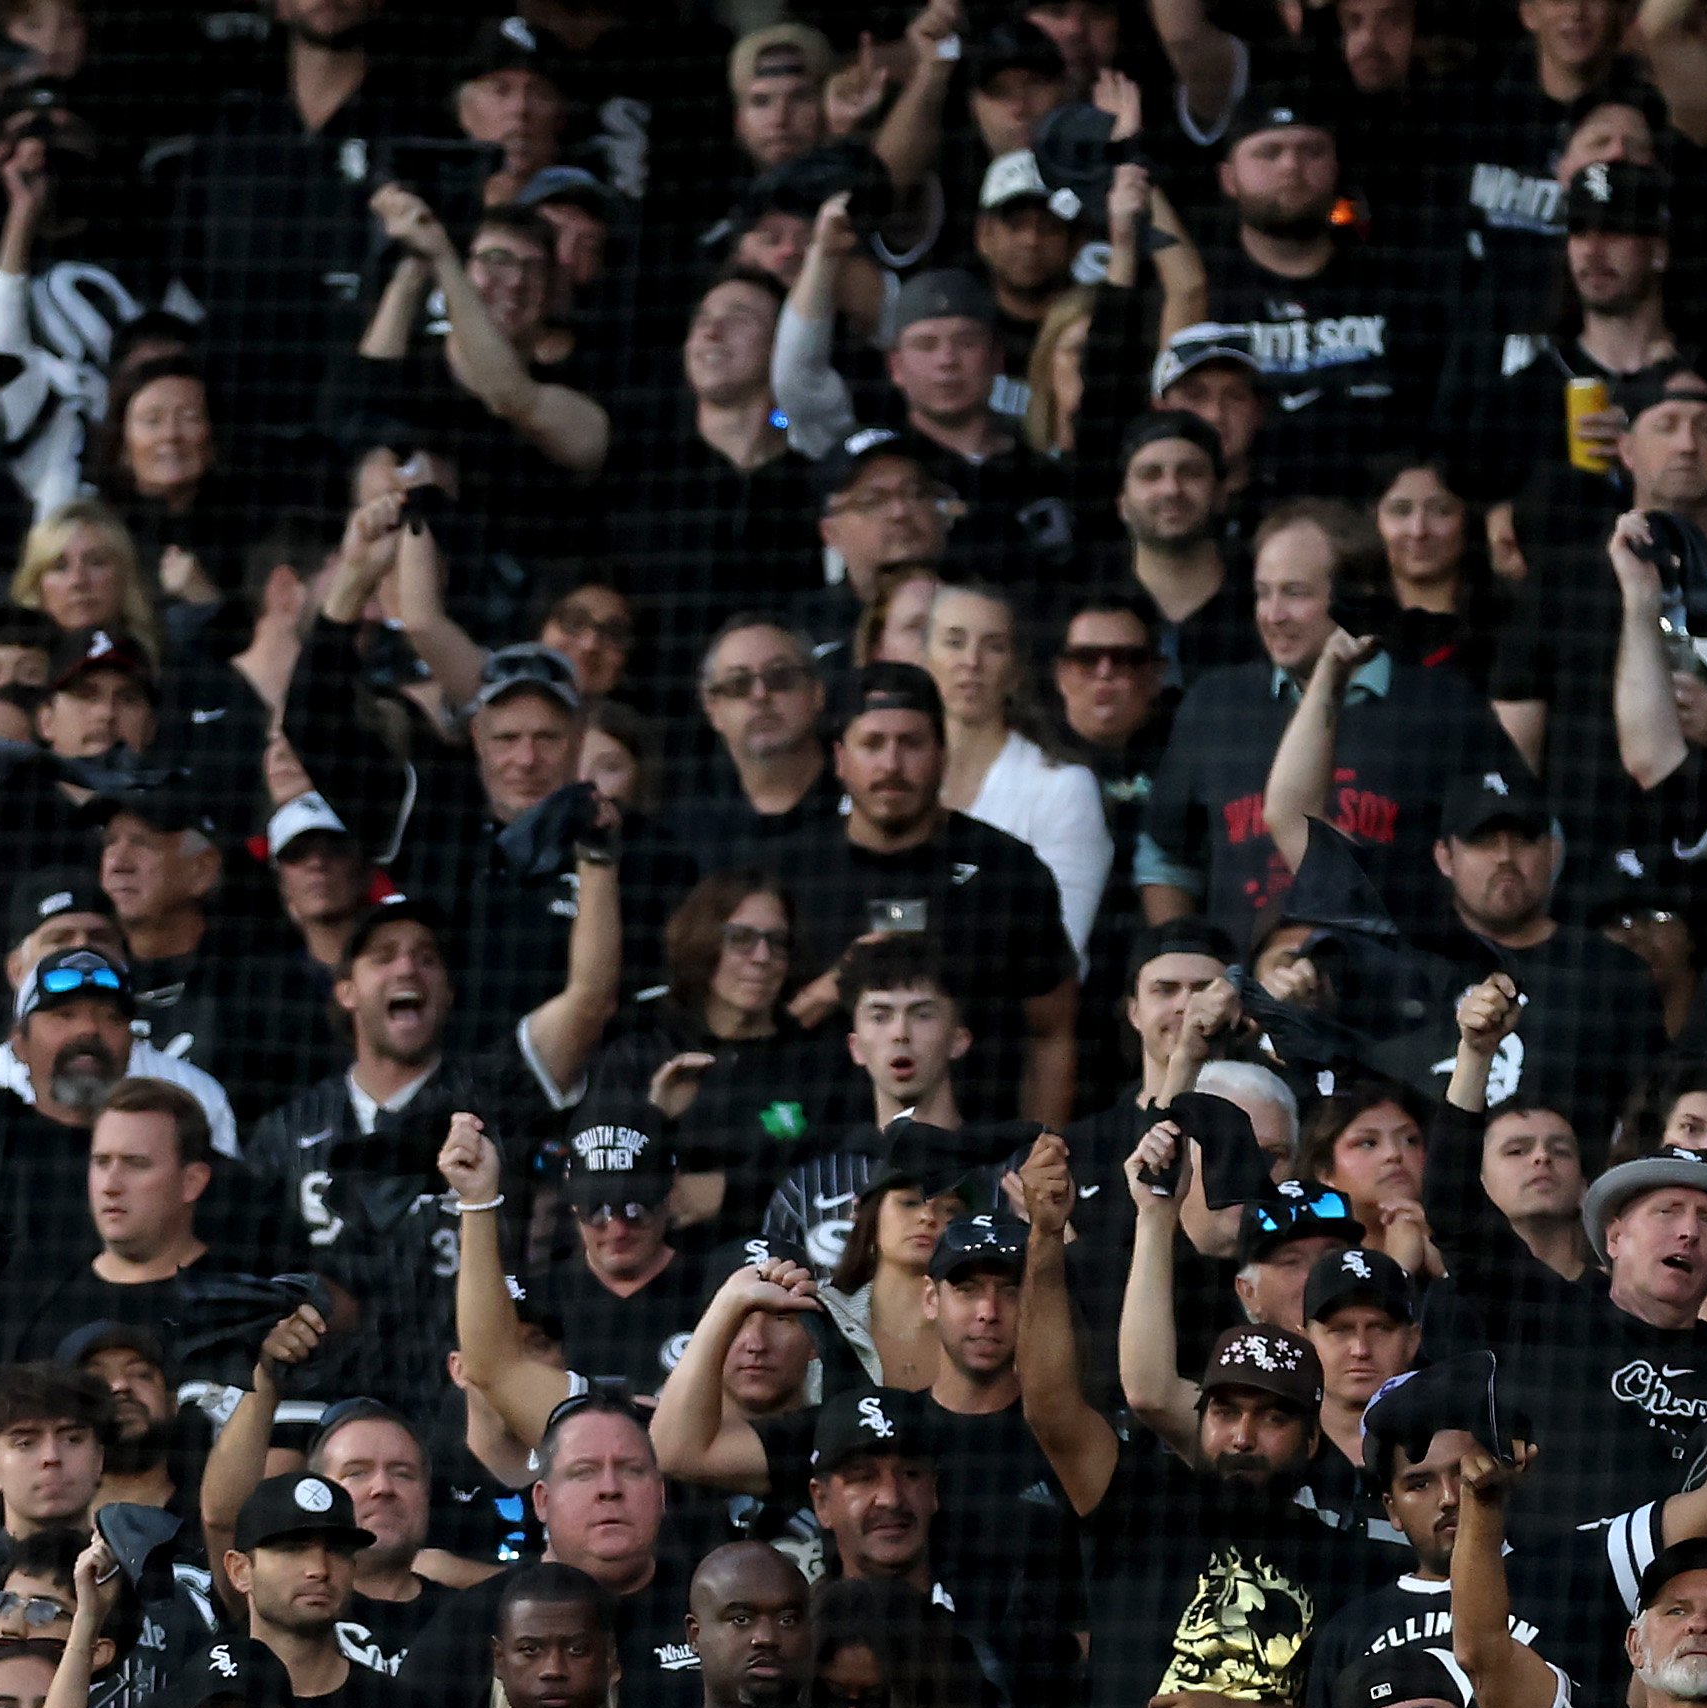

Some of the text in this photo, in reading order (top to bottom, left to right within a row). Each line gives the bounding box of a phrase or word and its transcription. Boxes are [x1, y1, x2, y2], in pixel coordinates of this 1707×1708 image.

[572, 1125, 650, 1157] SOUTH SIDE
[586, 1147, 634, 1171] HIT MEN
[858, 1397, 894, 1438] Sox
[210, 1645, 240, 1678] Sox
